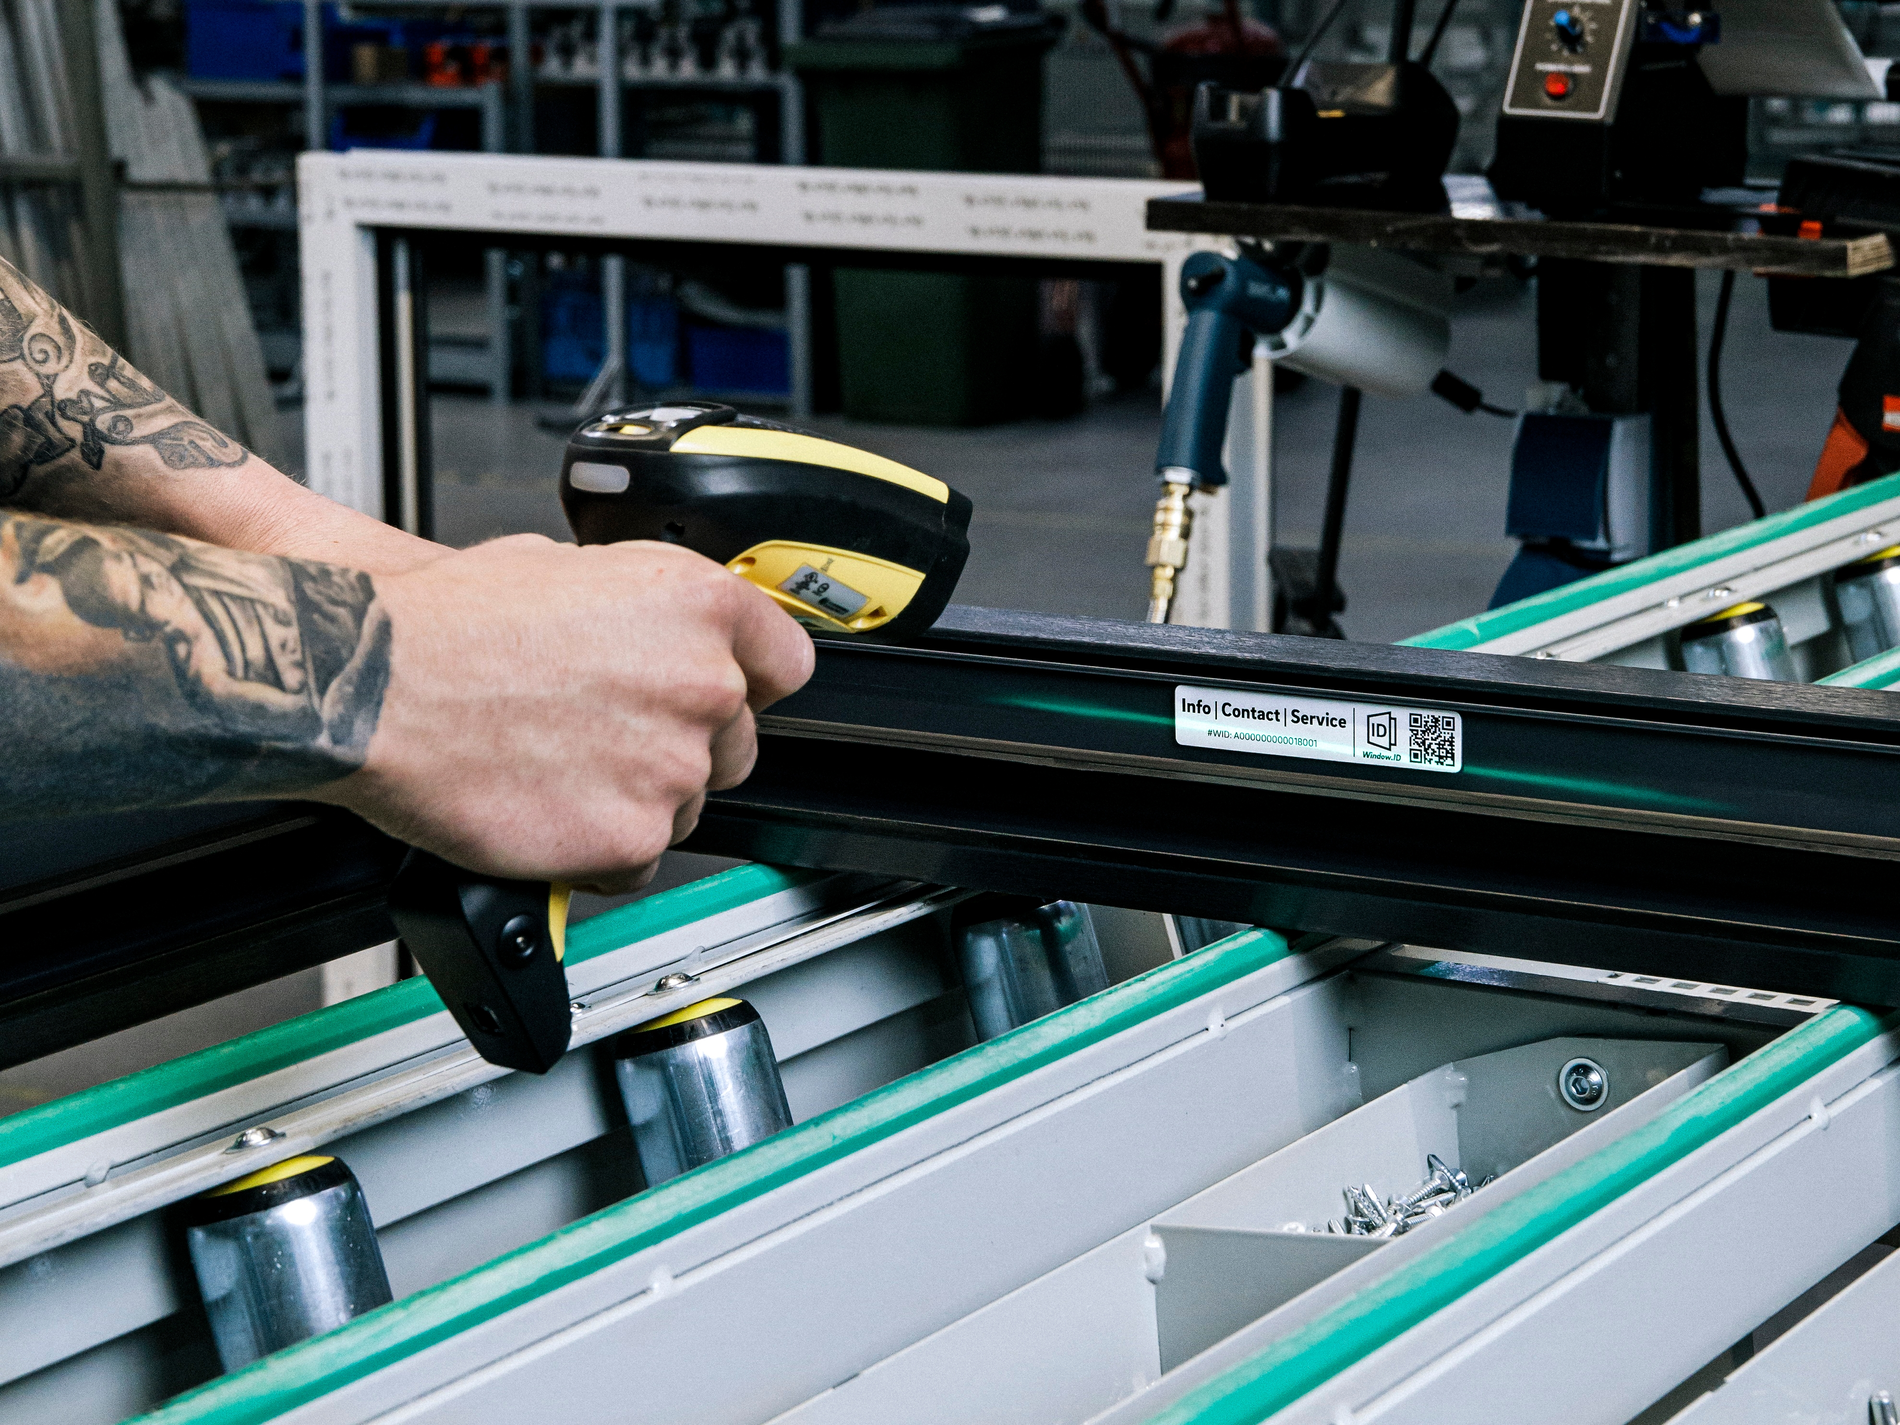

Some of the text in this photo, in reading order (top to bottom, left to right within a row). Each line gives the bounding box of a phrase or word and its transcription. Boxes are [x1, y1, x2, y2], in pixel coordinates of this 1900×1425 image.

[1182, 698, 1347, 728] Info Contact Service
[1208, 729, 1317, 747] #WID: A000000000018001
[1372, 723, 1387, 737] ID
